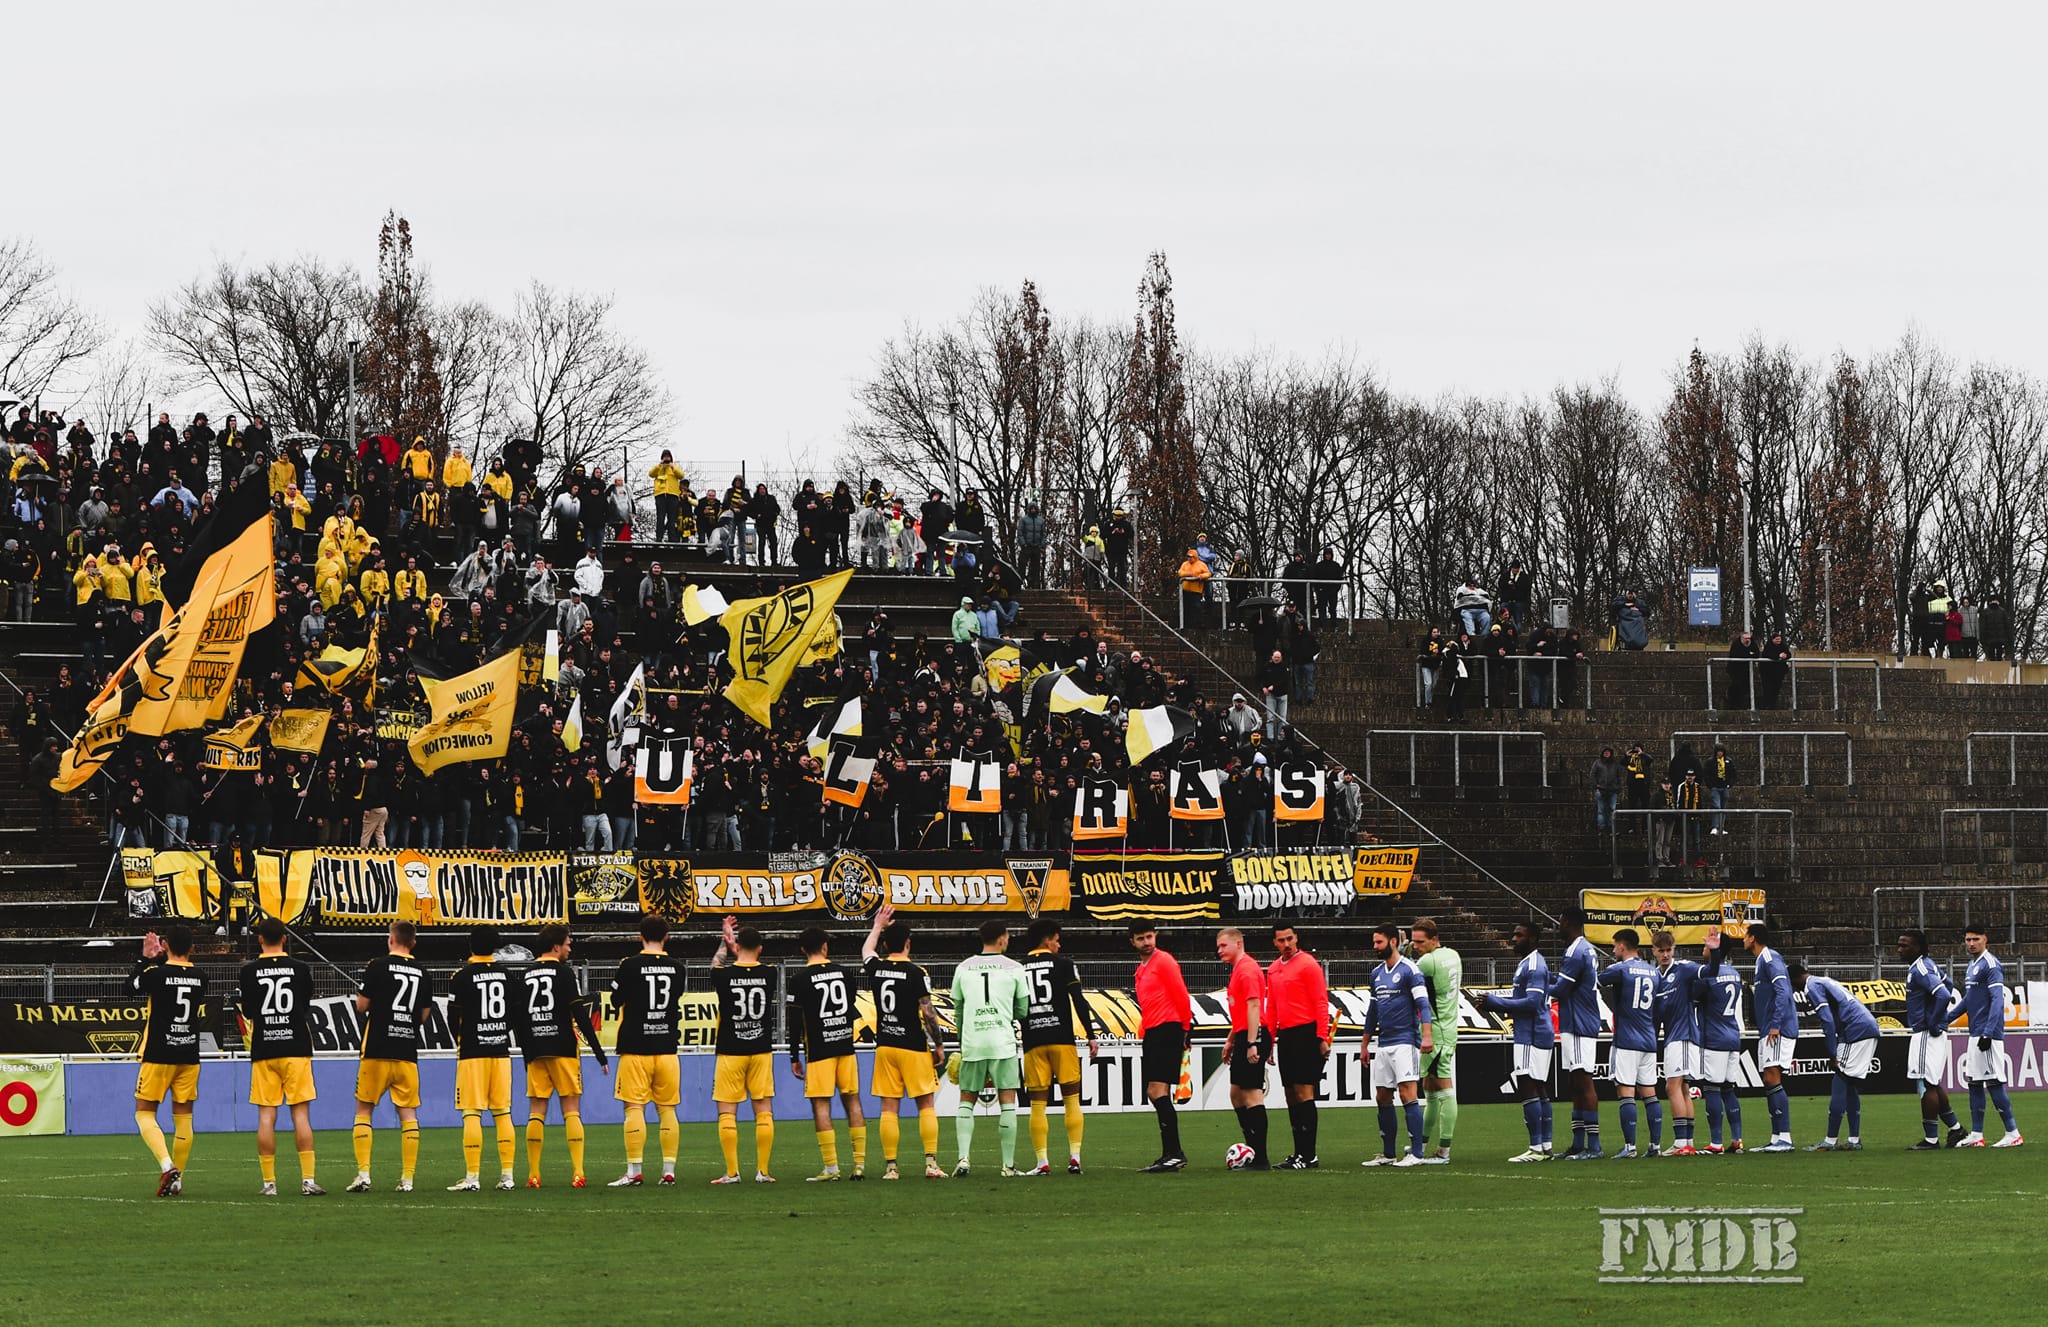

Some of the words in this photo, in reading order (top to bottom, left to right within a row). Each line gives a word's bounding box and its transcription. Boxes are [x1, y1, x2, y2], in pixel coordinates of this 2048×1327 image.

[1174, 760, 1220, 811] A
[1279, 760, 1317, 811] S
[1080, 776, 1119, 830] R
[599, 856, 634, 865] STADT
[1012, 861, 1049, 869] ALEMANNIA
[1232, 854, 1353, 884] BOXSTAFFEL
[1360, 853, 1413, 866] OECHER
[317, 857, 398, 915] YELLOW
[437, 862, 564, 920] CONNECTION
[695, 874, 817, 907] KARLS
[889, 874, 1007, 905] BANDE
[1236, 879, 1355, 911] HOOLIGANS
[580, 902, 600, 912] UND
[602, 902, 640, 911] VEREIN
[1587, 912, 1606, 921] Tivoli
[1608, 913, 1631, 922] Tigers
[1678, 913, 1699, 922] Since
[1702, 913, 1720, 922] 2007
[165, 977, 201, 986] ALEMANNIA
[256, 968, 294, 977] ALEMANNIA
[473, 972, 506, 982] ALEMANNIA
[641, 966, 676, 974] ALEMANNIA
[729, 978, 767, 986] ALEMANNIA
[875, 970, 907, 980] ALEMANNIA
[258, 977, 294, 1015] 26
[391, 974, 419, 1012] 27
[476, 981, 506, 1019] 18
[525, 976, 555, 1014] 23
[645, 975, 671, 1010] 13
[814, 980, 848, 1018] 29
[881, 980, 896, 1013] 6
[981, 972, 990, 1005] 1
[1025, 969, 1053, 1004] 15
[1632, 977, 1654, 1010] 13
[1723, 984, 1736, 1016] 2
[174, 986, 191, 1023] 5
[731, 987, 766, 1020] 30
[976, 1008, 998, 1016] JOHNEN
[264, 1016, 289, 1024] WILLMS
[735, 1021, 761, 1029] WINTER
[94, 1034, 136, 1042] Alemannia
